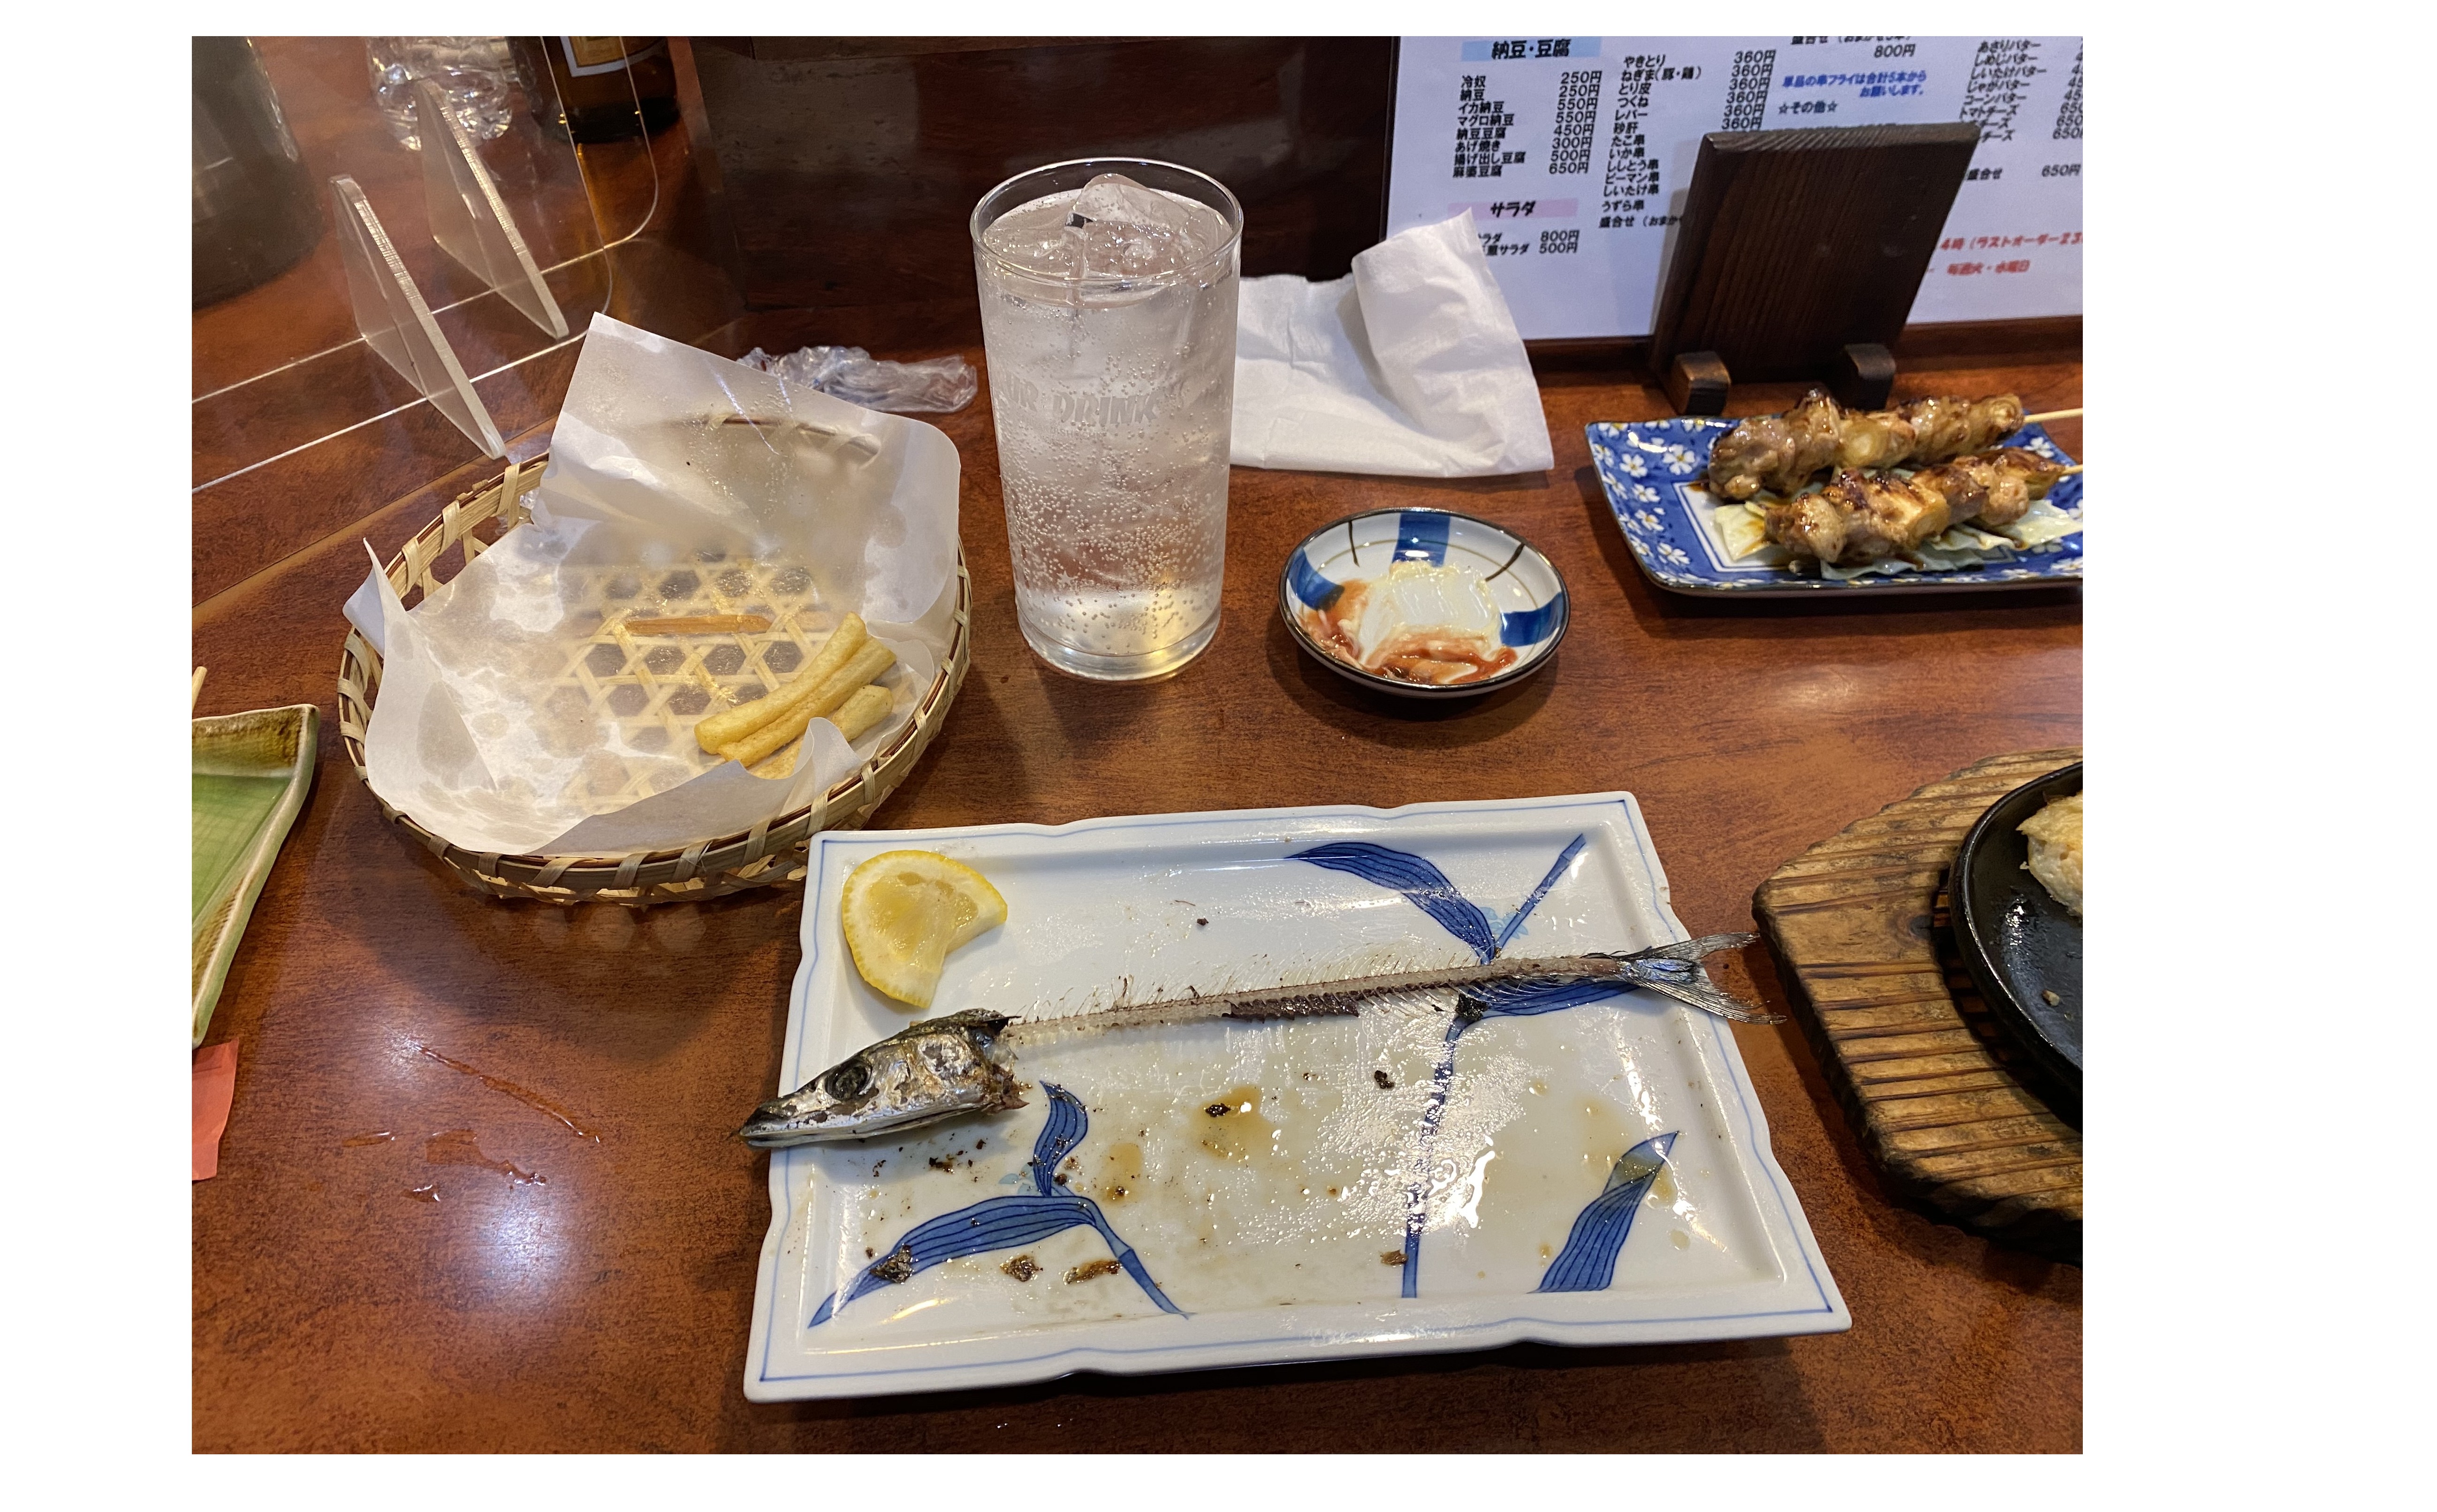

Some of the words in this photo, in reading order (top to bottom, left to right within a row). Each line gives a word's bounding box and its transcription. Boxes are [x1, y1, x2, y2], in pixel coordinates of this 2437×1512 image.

[1492, 38, 1571, 59] 納豆・豆腐
[1874, 44, 1916, 58] 800円
[1624, 54, 1666, 68] やきとり
[1734, 49, 1777, 63] 360円
[1731, 64, 1773, 77] 360円
[1461, 75, 1486, 88] 冷奴
[1561, 70, 1602, 84] 250円
[1619, 83, 1651, 95] とり皮
[1729, 77, 1770, 90] 360円
[1460, 89, 1484, 101] 納豆
[1559, 84, 1600, 98] 250円
[1617, 95, 1648, 108] つくね
[1726, 91, 1768, 103] 360円
[1458, 101, 1504, 114] イカ納豆
[1557, 97, 1598, 110] 550円
[1615, 110, 1648, 121] レバー
[1724, 104, 1765, 117] 360円
[1458, 114, 1514, 126] マグロ納豆
[1556, 110, 1595, 124] 550円
[1722, 117, 1762, 130] 360円
[1456, 127, 1506, 140] 納豆豆腐
[1554, 124, 1594, 136] 450円
[1455, 140, 1500, 152] あげ焼き
[1552, 137, 1592, 149] 300円
[1455, 152, 1526, 165] 揚げ出し豆腐
[1550, 150, 1590, 162] 500円
[1549, 162, 1588, 174] 650円
[2041, 164, 2081, 177] 650円
[1490, 200, 1536, 218] サラダ
[1478, 232, 1503, 244] ラダ
[1541, 229, 1579, 242] 800円
[1539, 242, 1578, 254] 500円
[1053, 389, 1163, 424] DRINK
